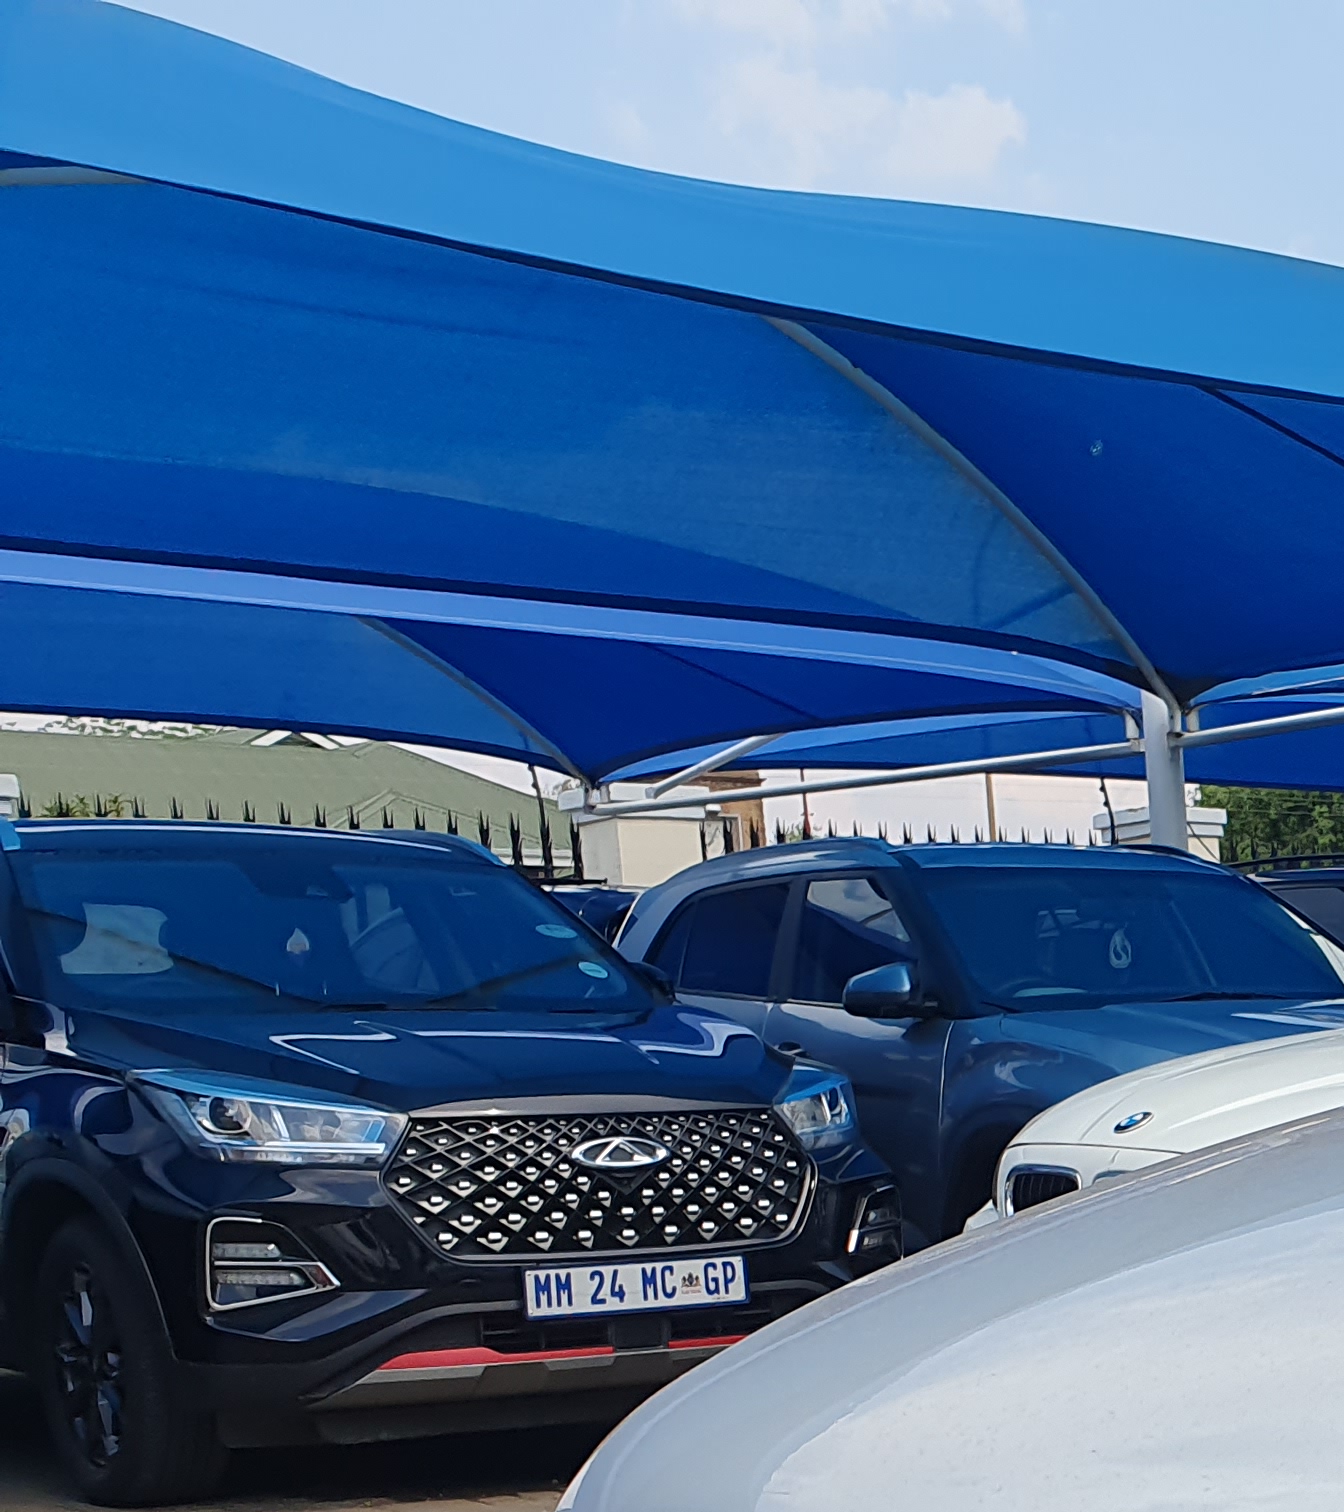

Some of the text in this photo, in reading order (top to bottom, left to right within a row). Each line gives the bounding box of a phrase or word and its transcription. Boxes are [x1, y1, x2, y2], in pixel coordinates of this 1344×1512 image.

[533, 1261, 737, 1309] MM 24 MC GP
